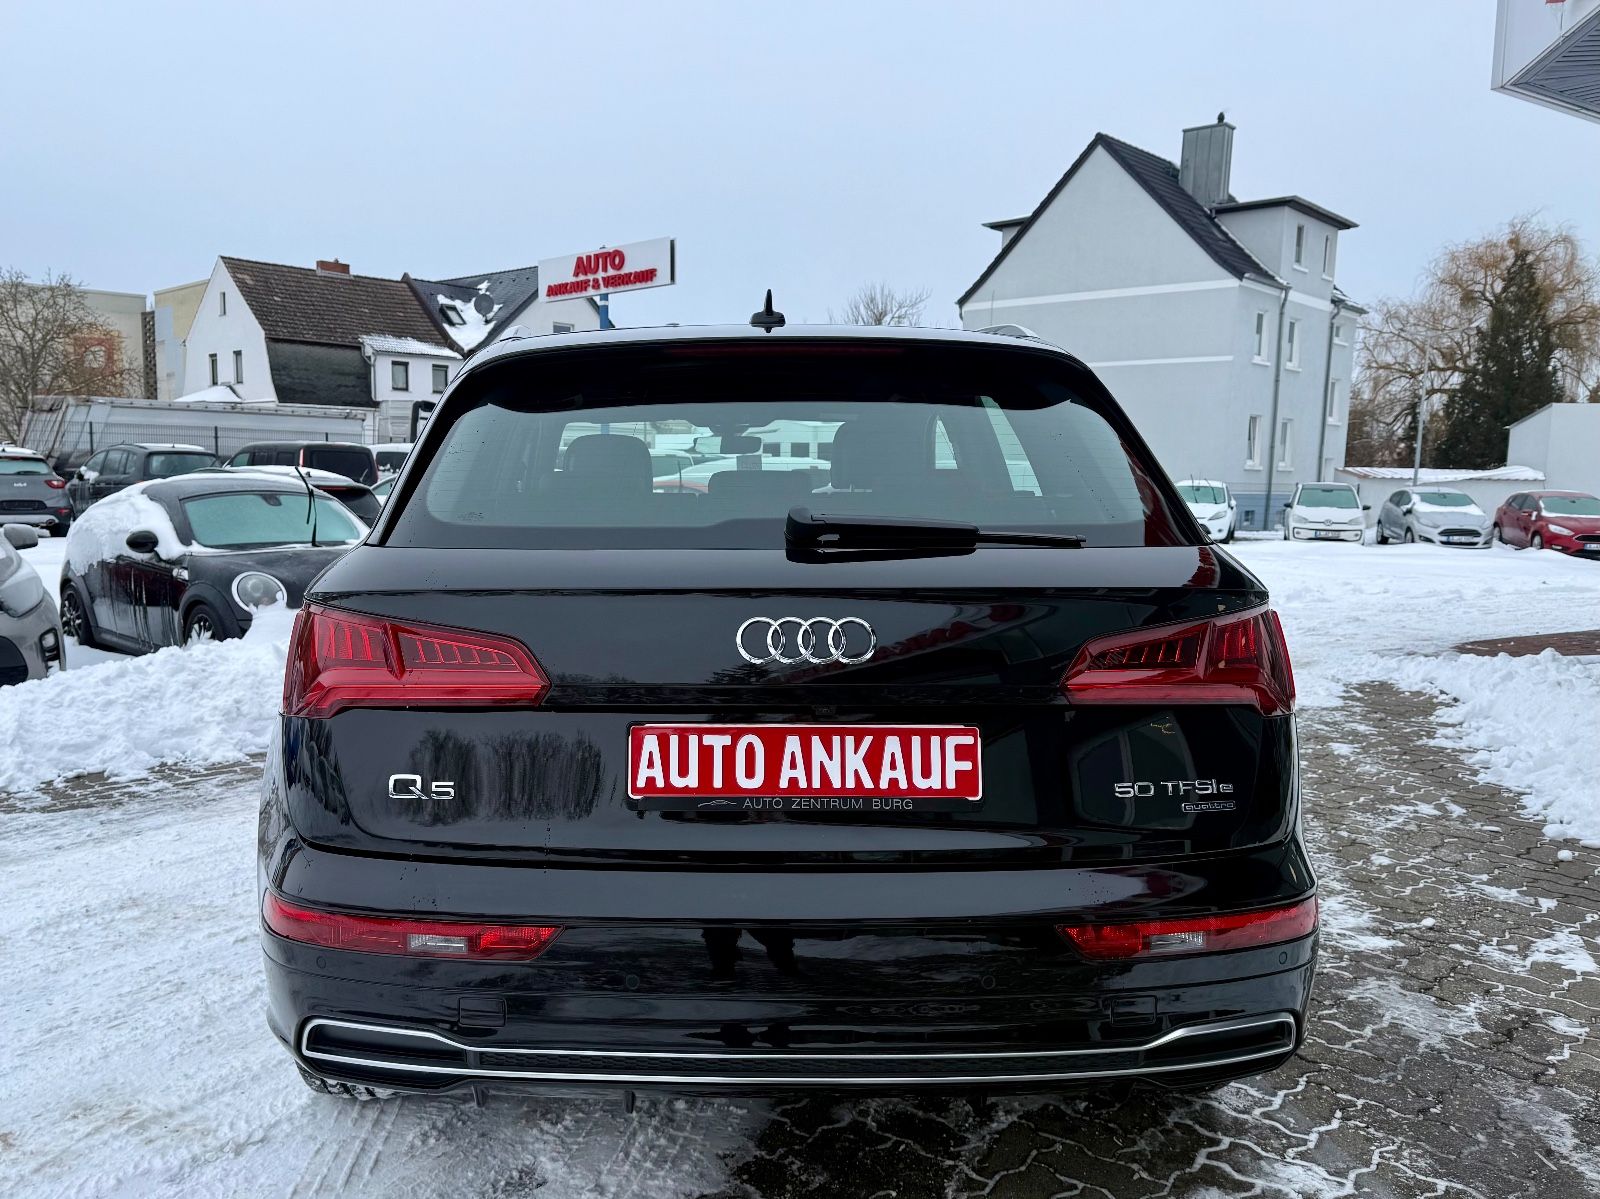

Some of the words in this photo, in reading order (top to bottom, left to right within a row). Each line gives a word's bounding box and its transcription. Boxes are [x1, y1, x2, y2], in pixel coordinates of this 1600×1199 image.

[573, 249, 625, 277] AUTO
[546, 279, 591, 297] ANKAUF
[592, 277, 600, 290] &
[602, 268, 657, 288] VERKAUF
[636, 734, 765, 789] AUTO
[779, 735, 975, 790] ANKAUF
[388, 773, 455, 800] Q5
[1114, 781, 1155, 798] 50
[742, 798, 783, 809] AUTO
[791, 798, 863, 809] ZENTRUM
[872, 798, 913, 810] BURG
[1185, 802, 1234, 811] quattro
